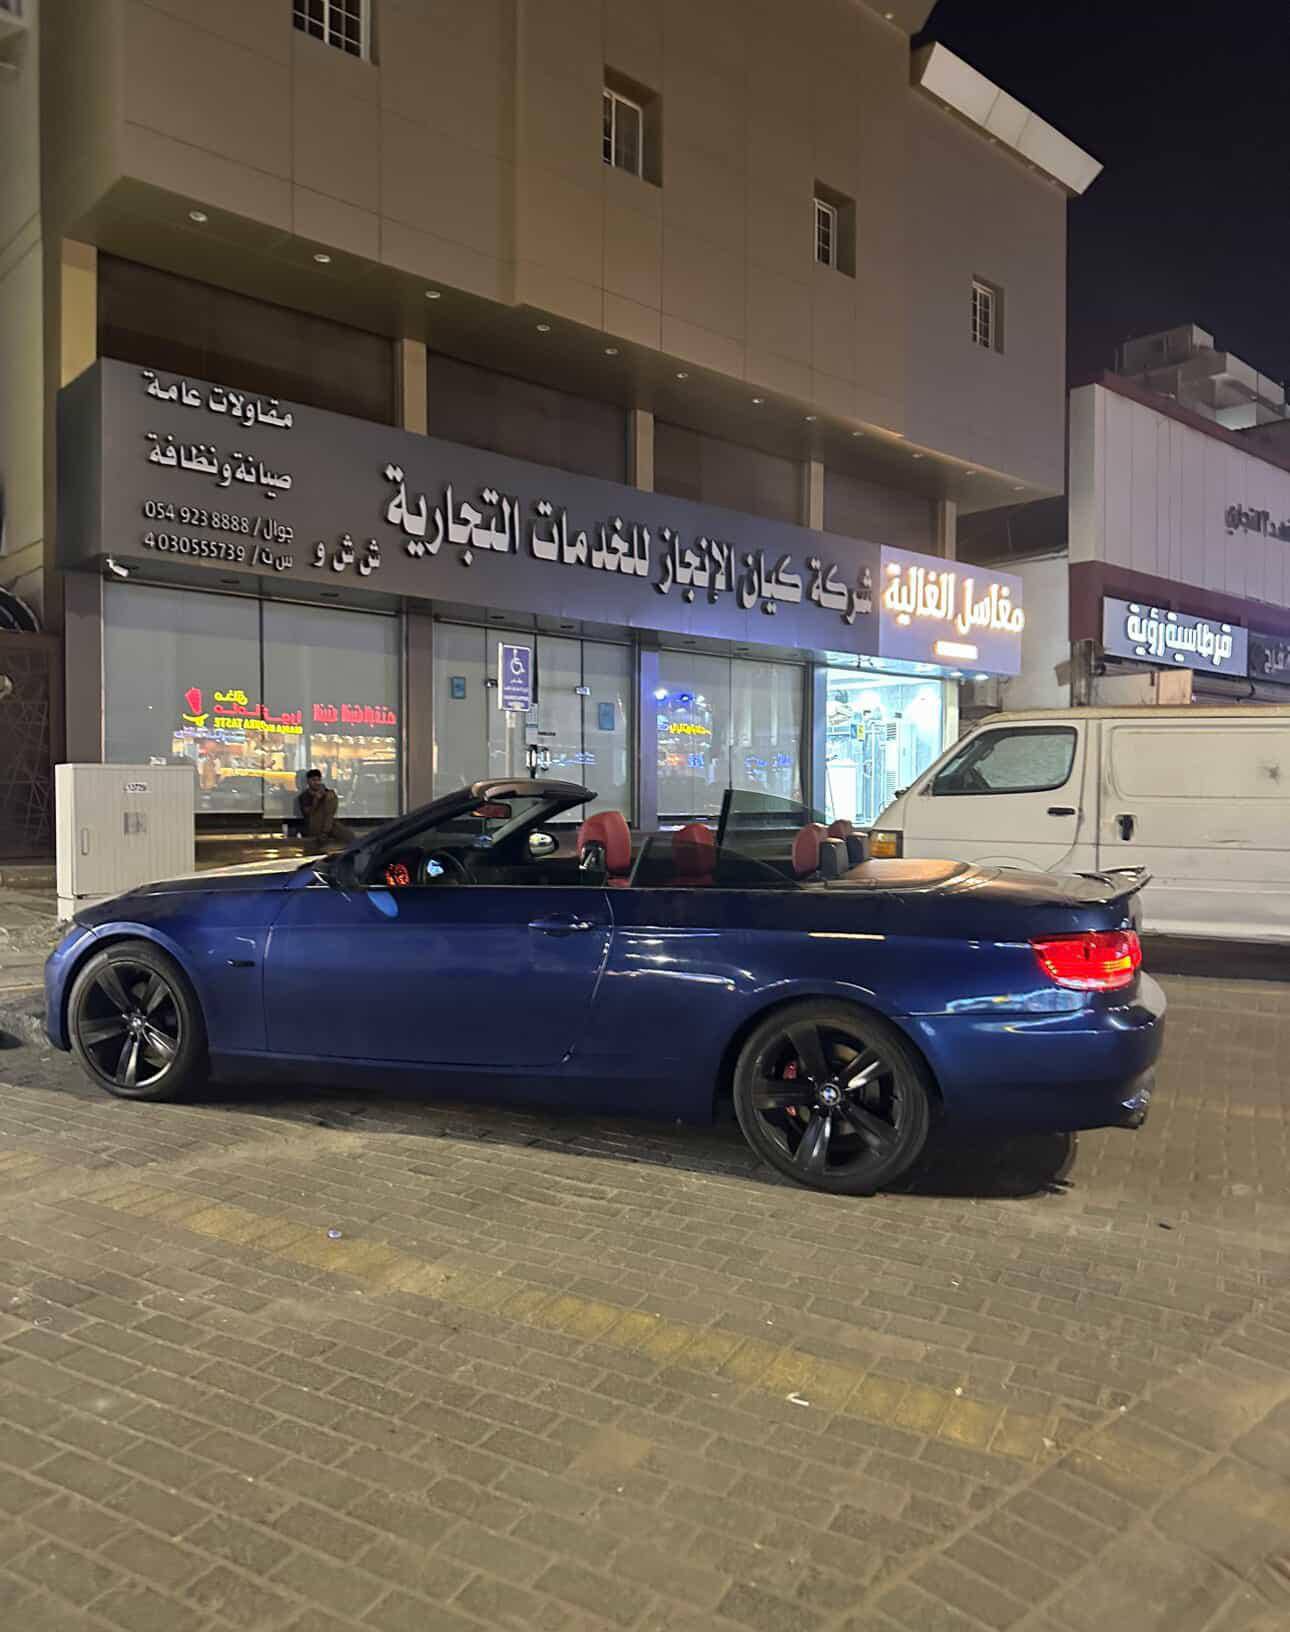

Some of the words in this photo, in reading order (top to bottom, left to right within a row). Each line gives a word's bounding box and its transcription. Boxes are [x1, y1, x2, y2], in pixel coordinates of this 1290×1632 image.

[143, 369, 201, 408] عامة
[208, 385, 293, 428] مقاولات
[232, 451, 293, 499] صيانة
[145, 500, 175, 520] 054
[180, 506, 208, 526] 923
[211, 511, 249, 533] 8888
[264, 516, 294, 544] جوال
[383, 463, 520, 567] التجارية
[312, 541, 325, 568] و
[532, 500, 650, 577] للخدمات
[742, 552, 802, 616] كيان
[810, 556, 874, 625] شركة
[884, 562, 955, 626] الغالية
[956, 578, 1025, 634] مغاسل
